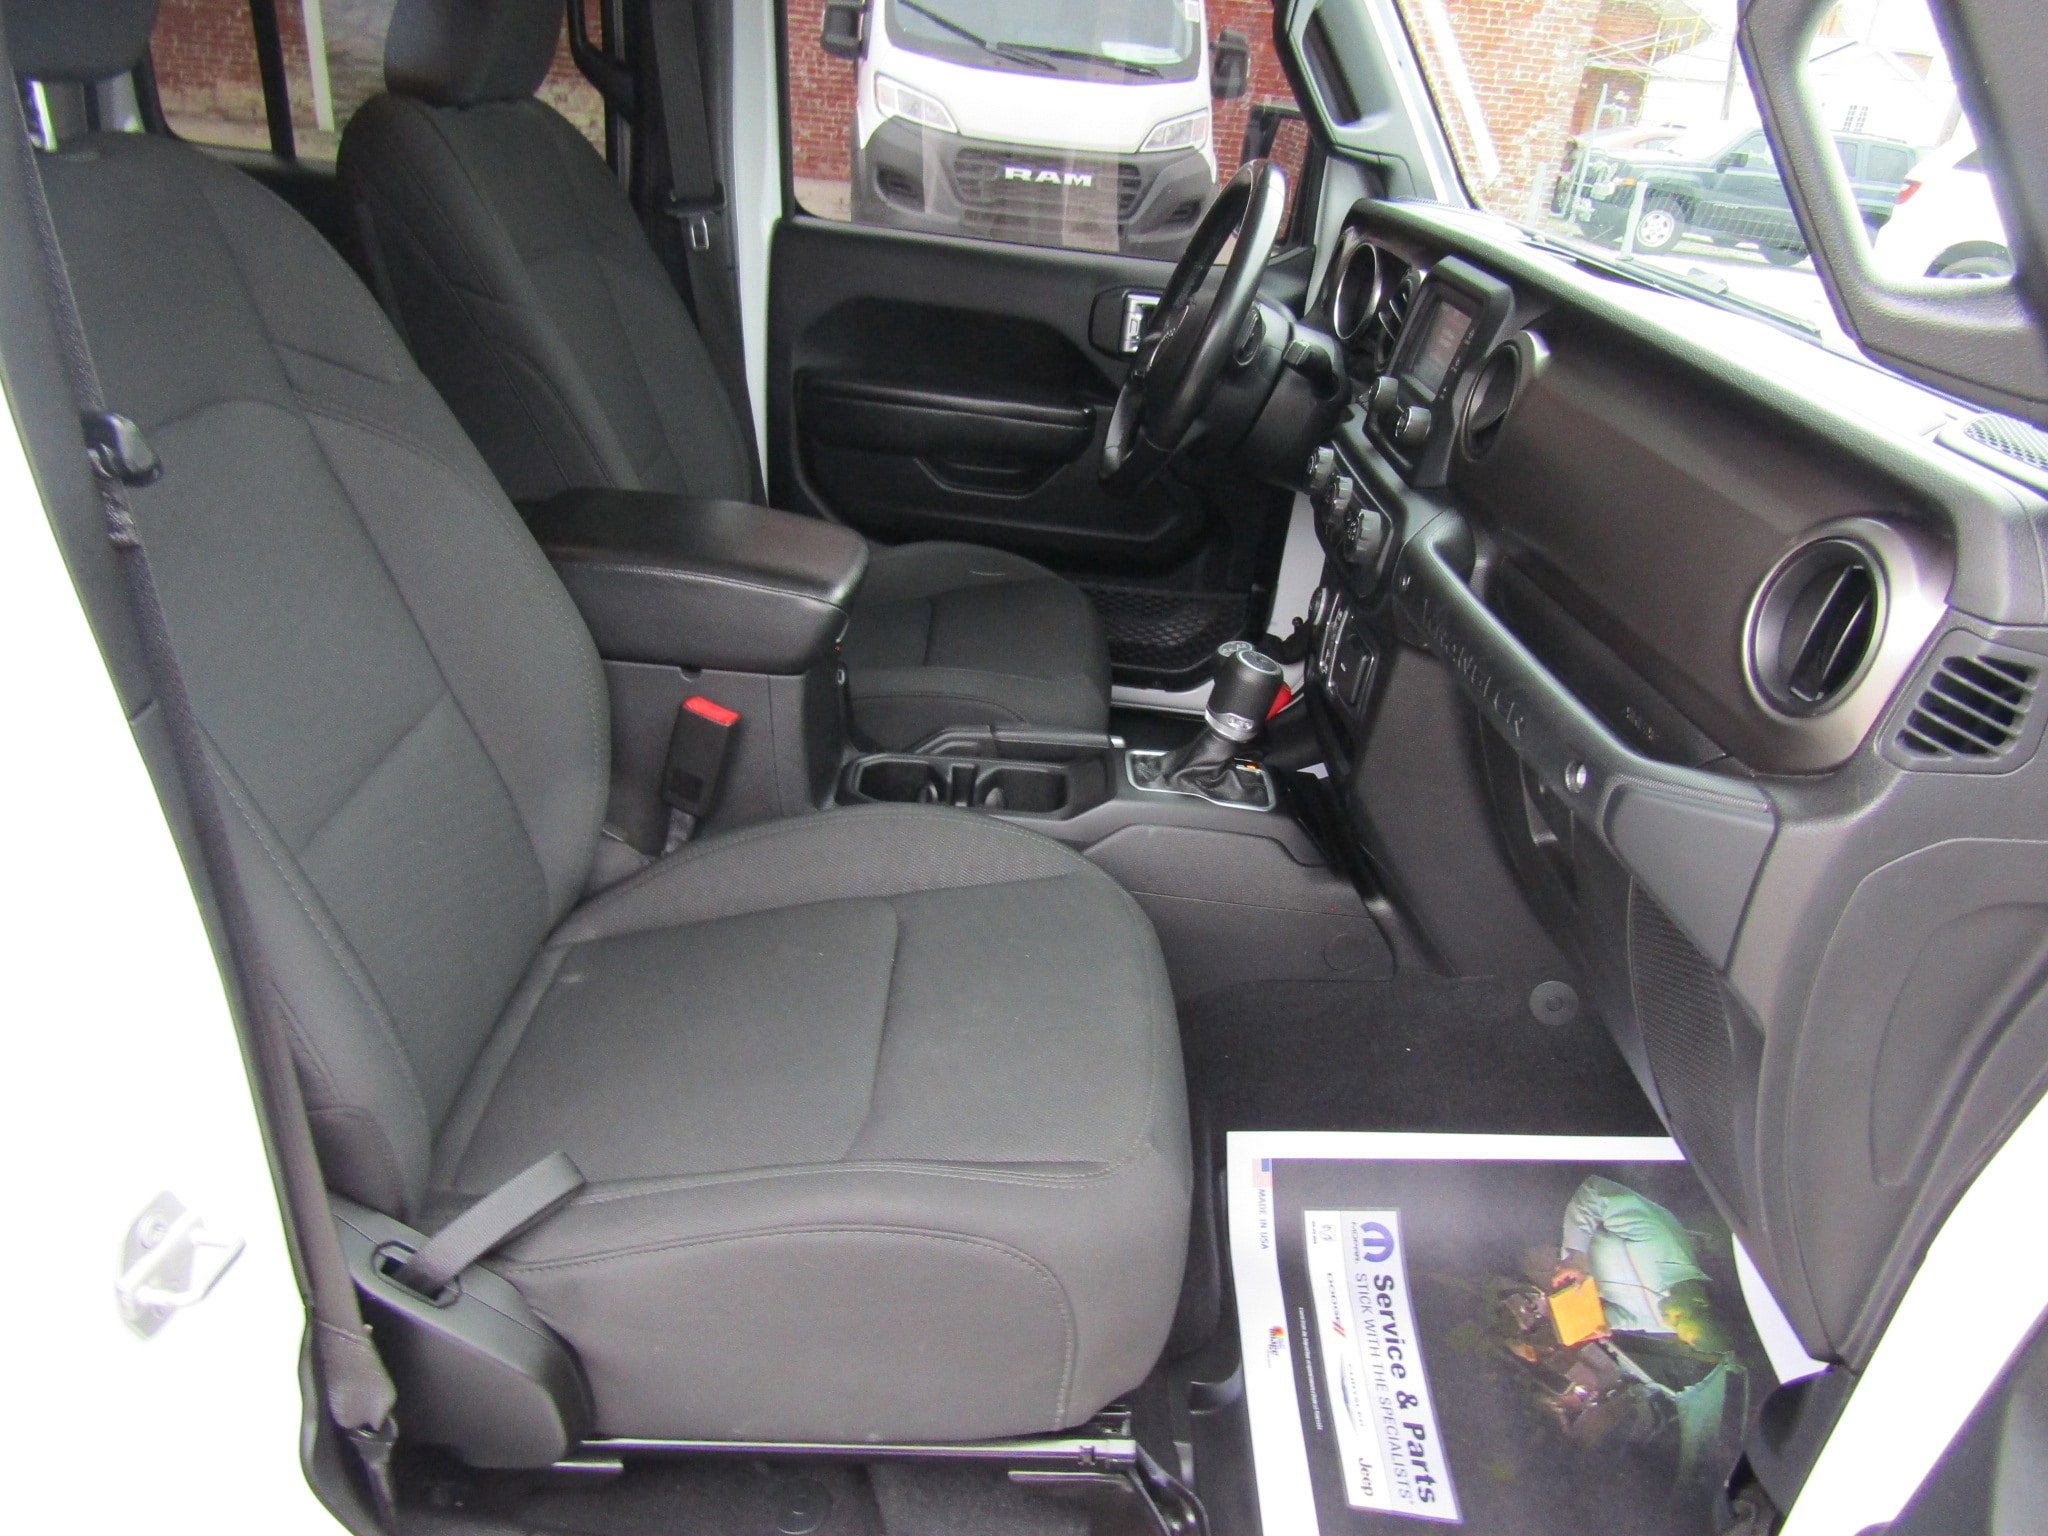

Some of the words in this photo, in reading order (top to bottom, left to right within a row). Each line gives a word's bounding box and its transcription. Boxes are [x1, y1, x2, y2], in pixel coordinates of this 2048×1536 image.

[1004, 166, 1093, 187] RAM
[1258, 1188, 1268, 1215] MADE
[1260, 1218, 1268, 1229] IN
[1260, 1231, 1270, 1250] USA
[1355, 1272, 1373, 1314] STICK
[1364, 1318, 1382, 1357] WITH
[1374, 1274, 1406, 1380] Service
[1371, 1363, 1389, 1394] THE
[1397, 1390, 1418, 1410] &
[1359, 1457, 1374, 1497] Jeep
[1403, 1421, 1436, 1503] Parts
